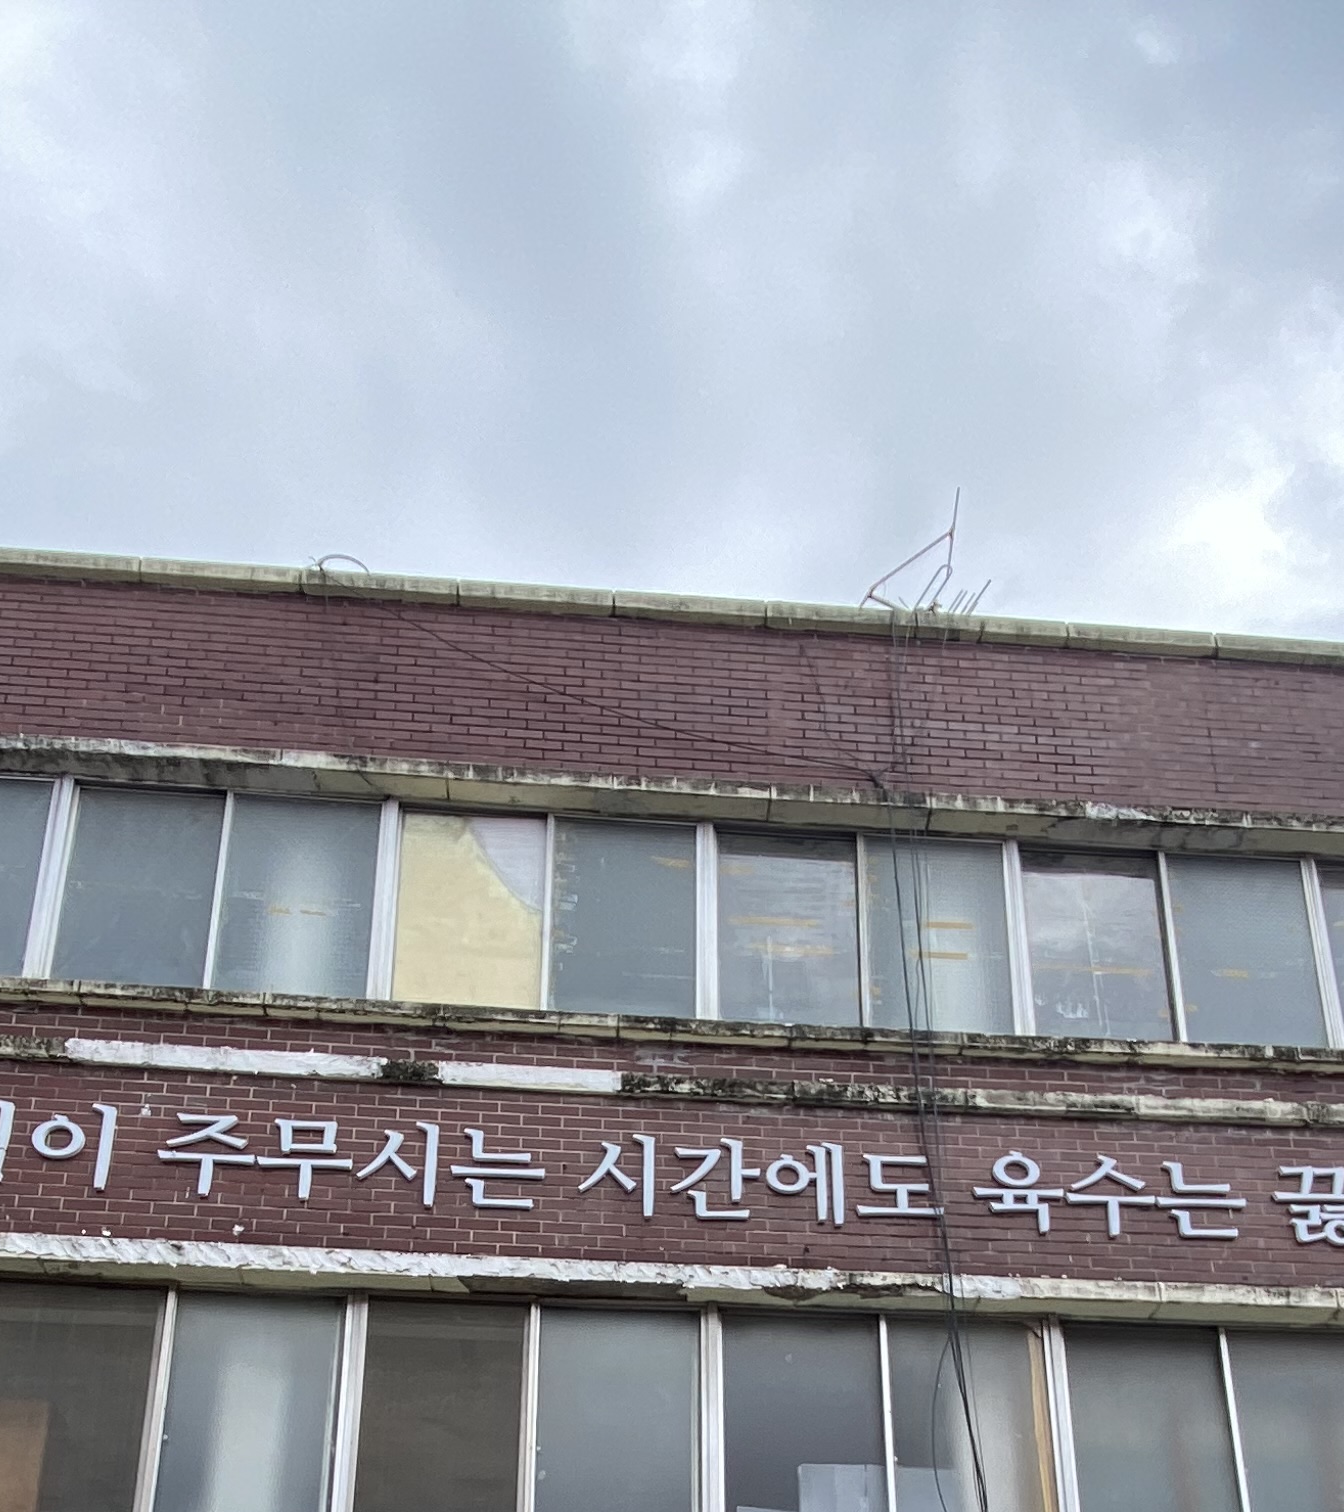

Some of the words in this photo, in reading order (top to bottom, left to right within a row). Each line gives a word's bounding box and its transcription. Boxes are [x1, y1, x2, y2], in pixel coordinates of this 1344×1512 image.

[157, 1112, 545, 1210] 주무시는
[576, 1132, 943, 1225] 시간에도
[973, 1150, 1247, 1239] 육수는
